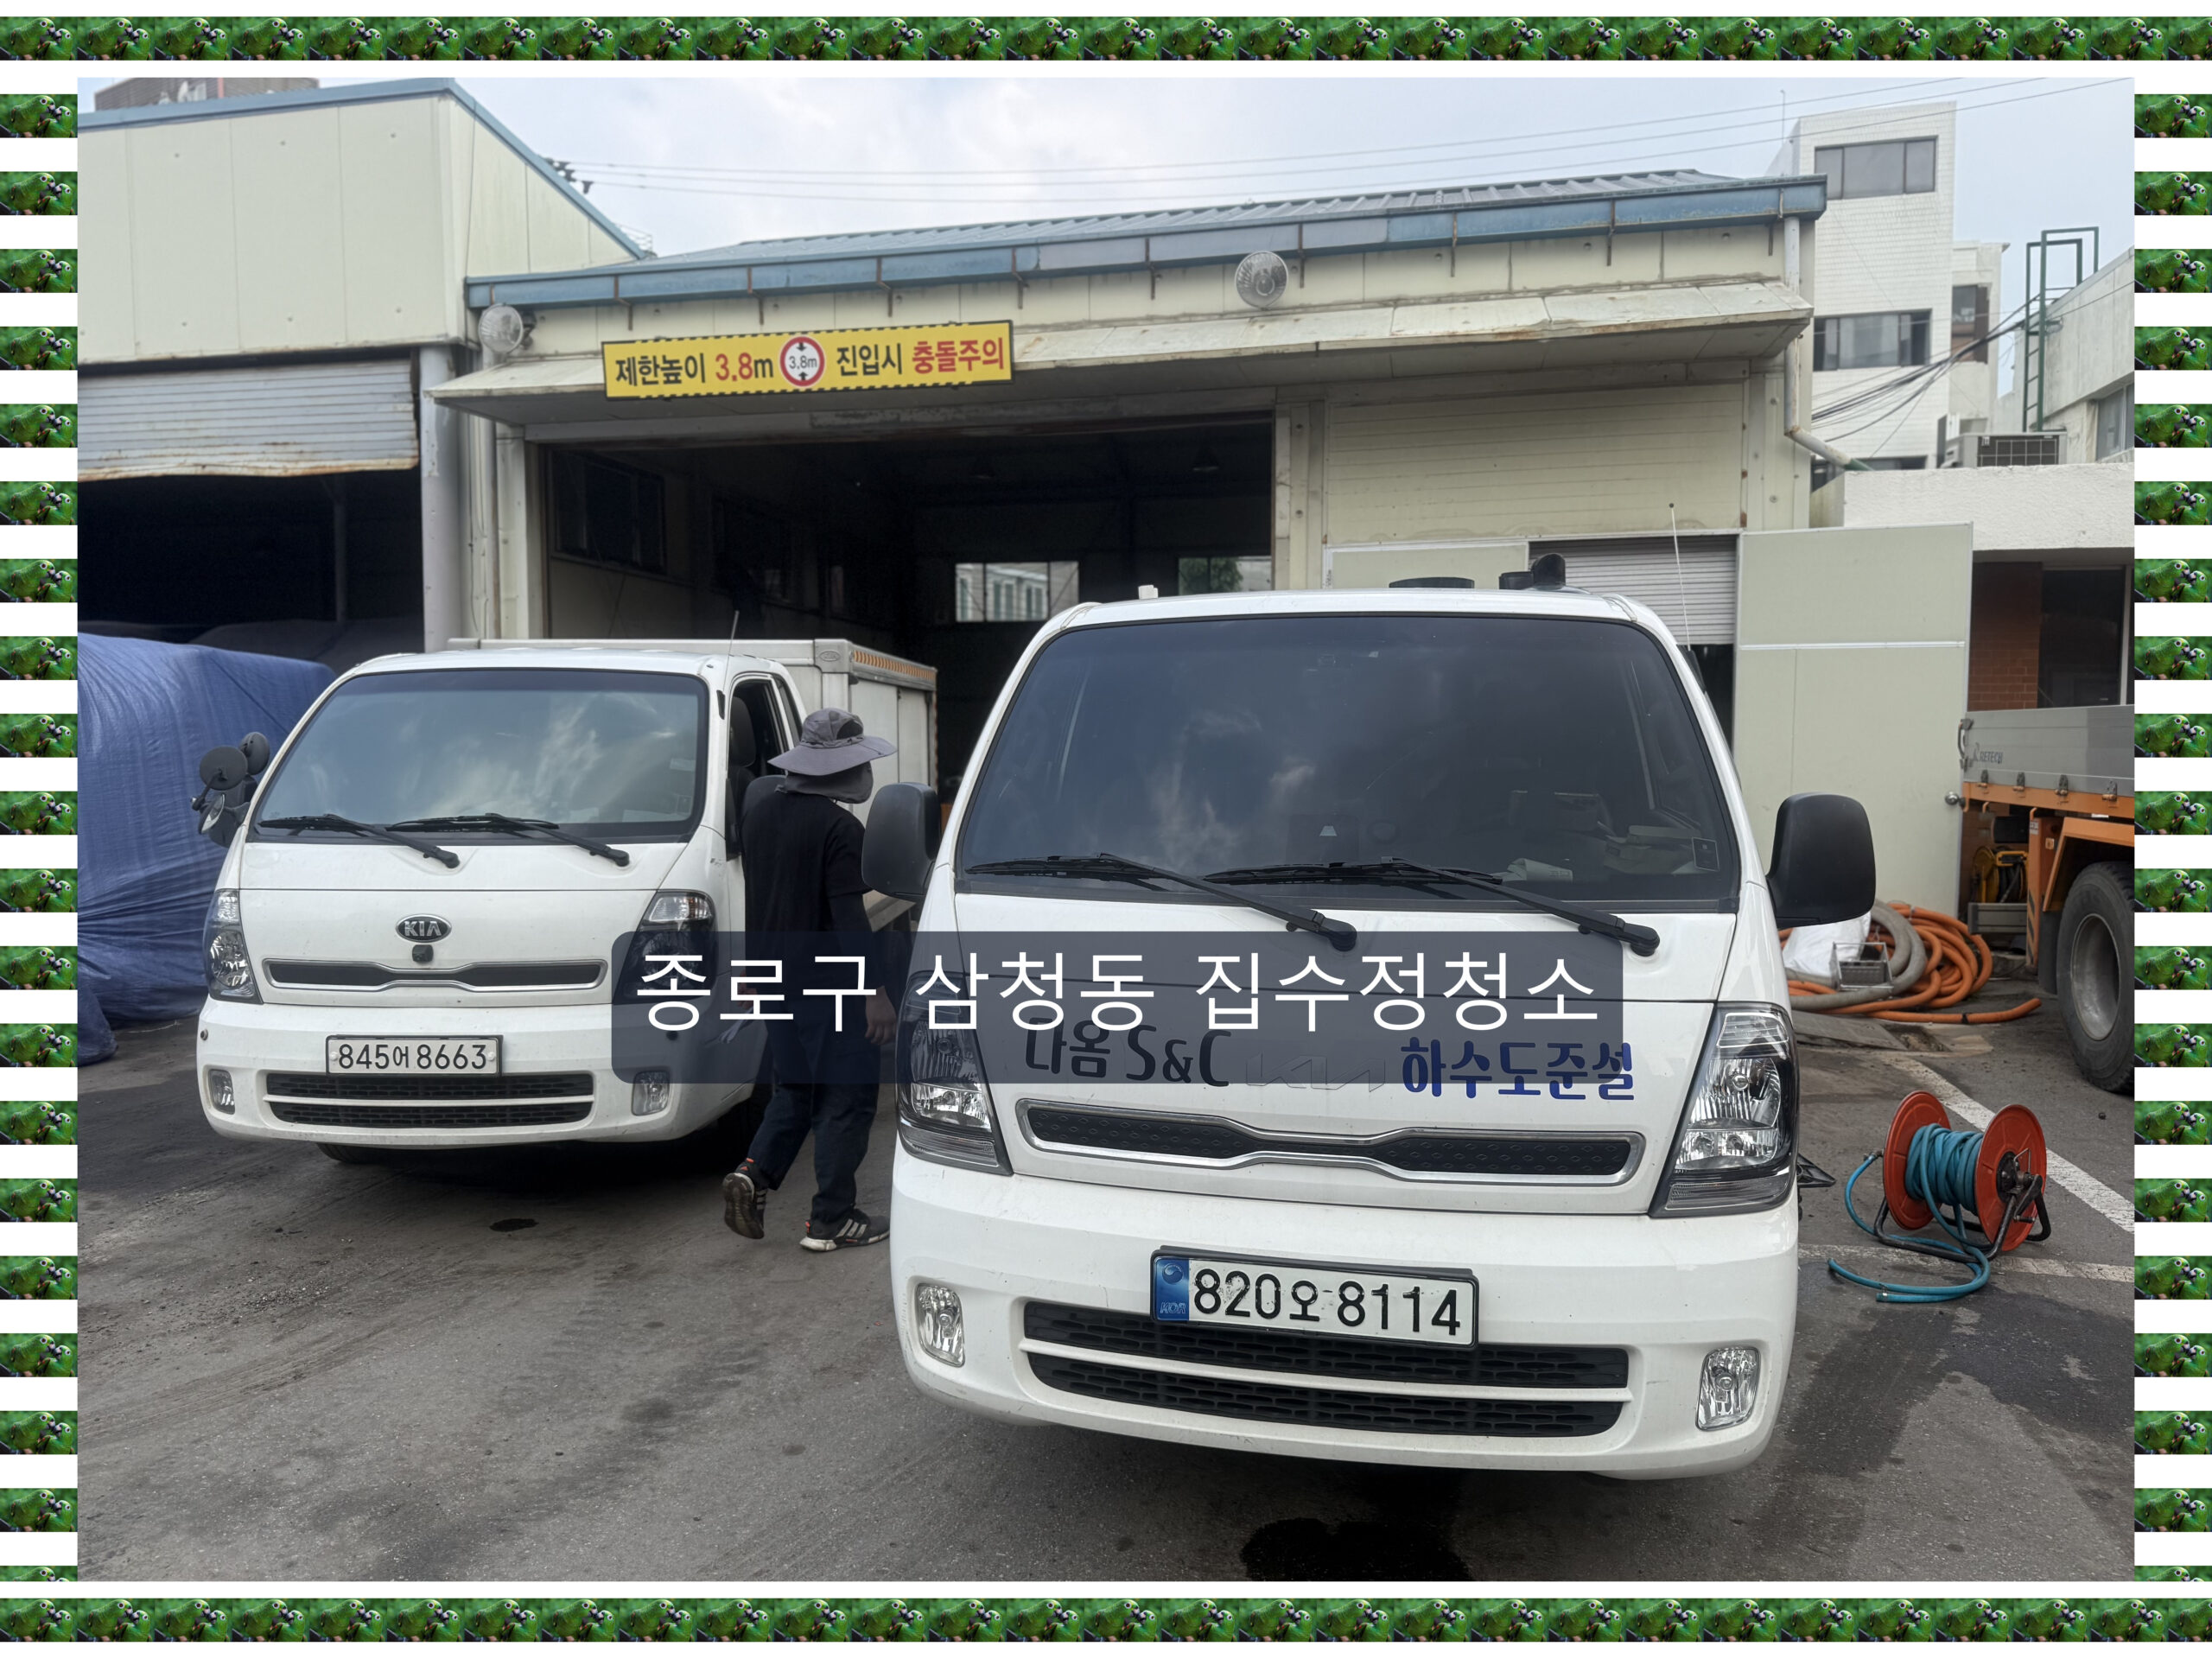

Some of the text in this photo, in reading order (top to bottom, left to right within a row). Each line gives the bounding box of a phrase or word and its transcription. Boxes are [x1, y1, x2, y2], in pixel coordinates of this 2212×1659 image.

[615, 337, 1004, 386] 제한높이 3.8m 진입시 충돌주의
[404, 920, 442, 937] KIA
[1126, 1025, 1231, 1088] S&C
[1401, 1037, 1635, 1101] 하수도준설
[1160, 1302, 1186, 1315] KOR
